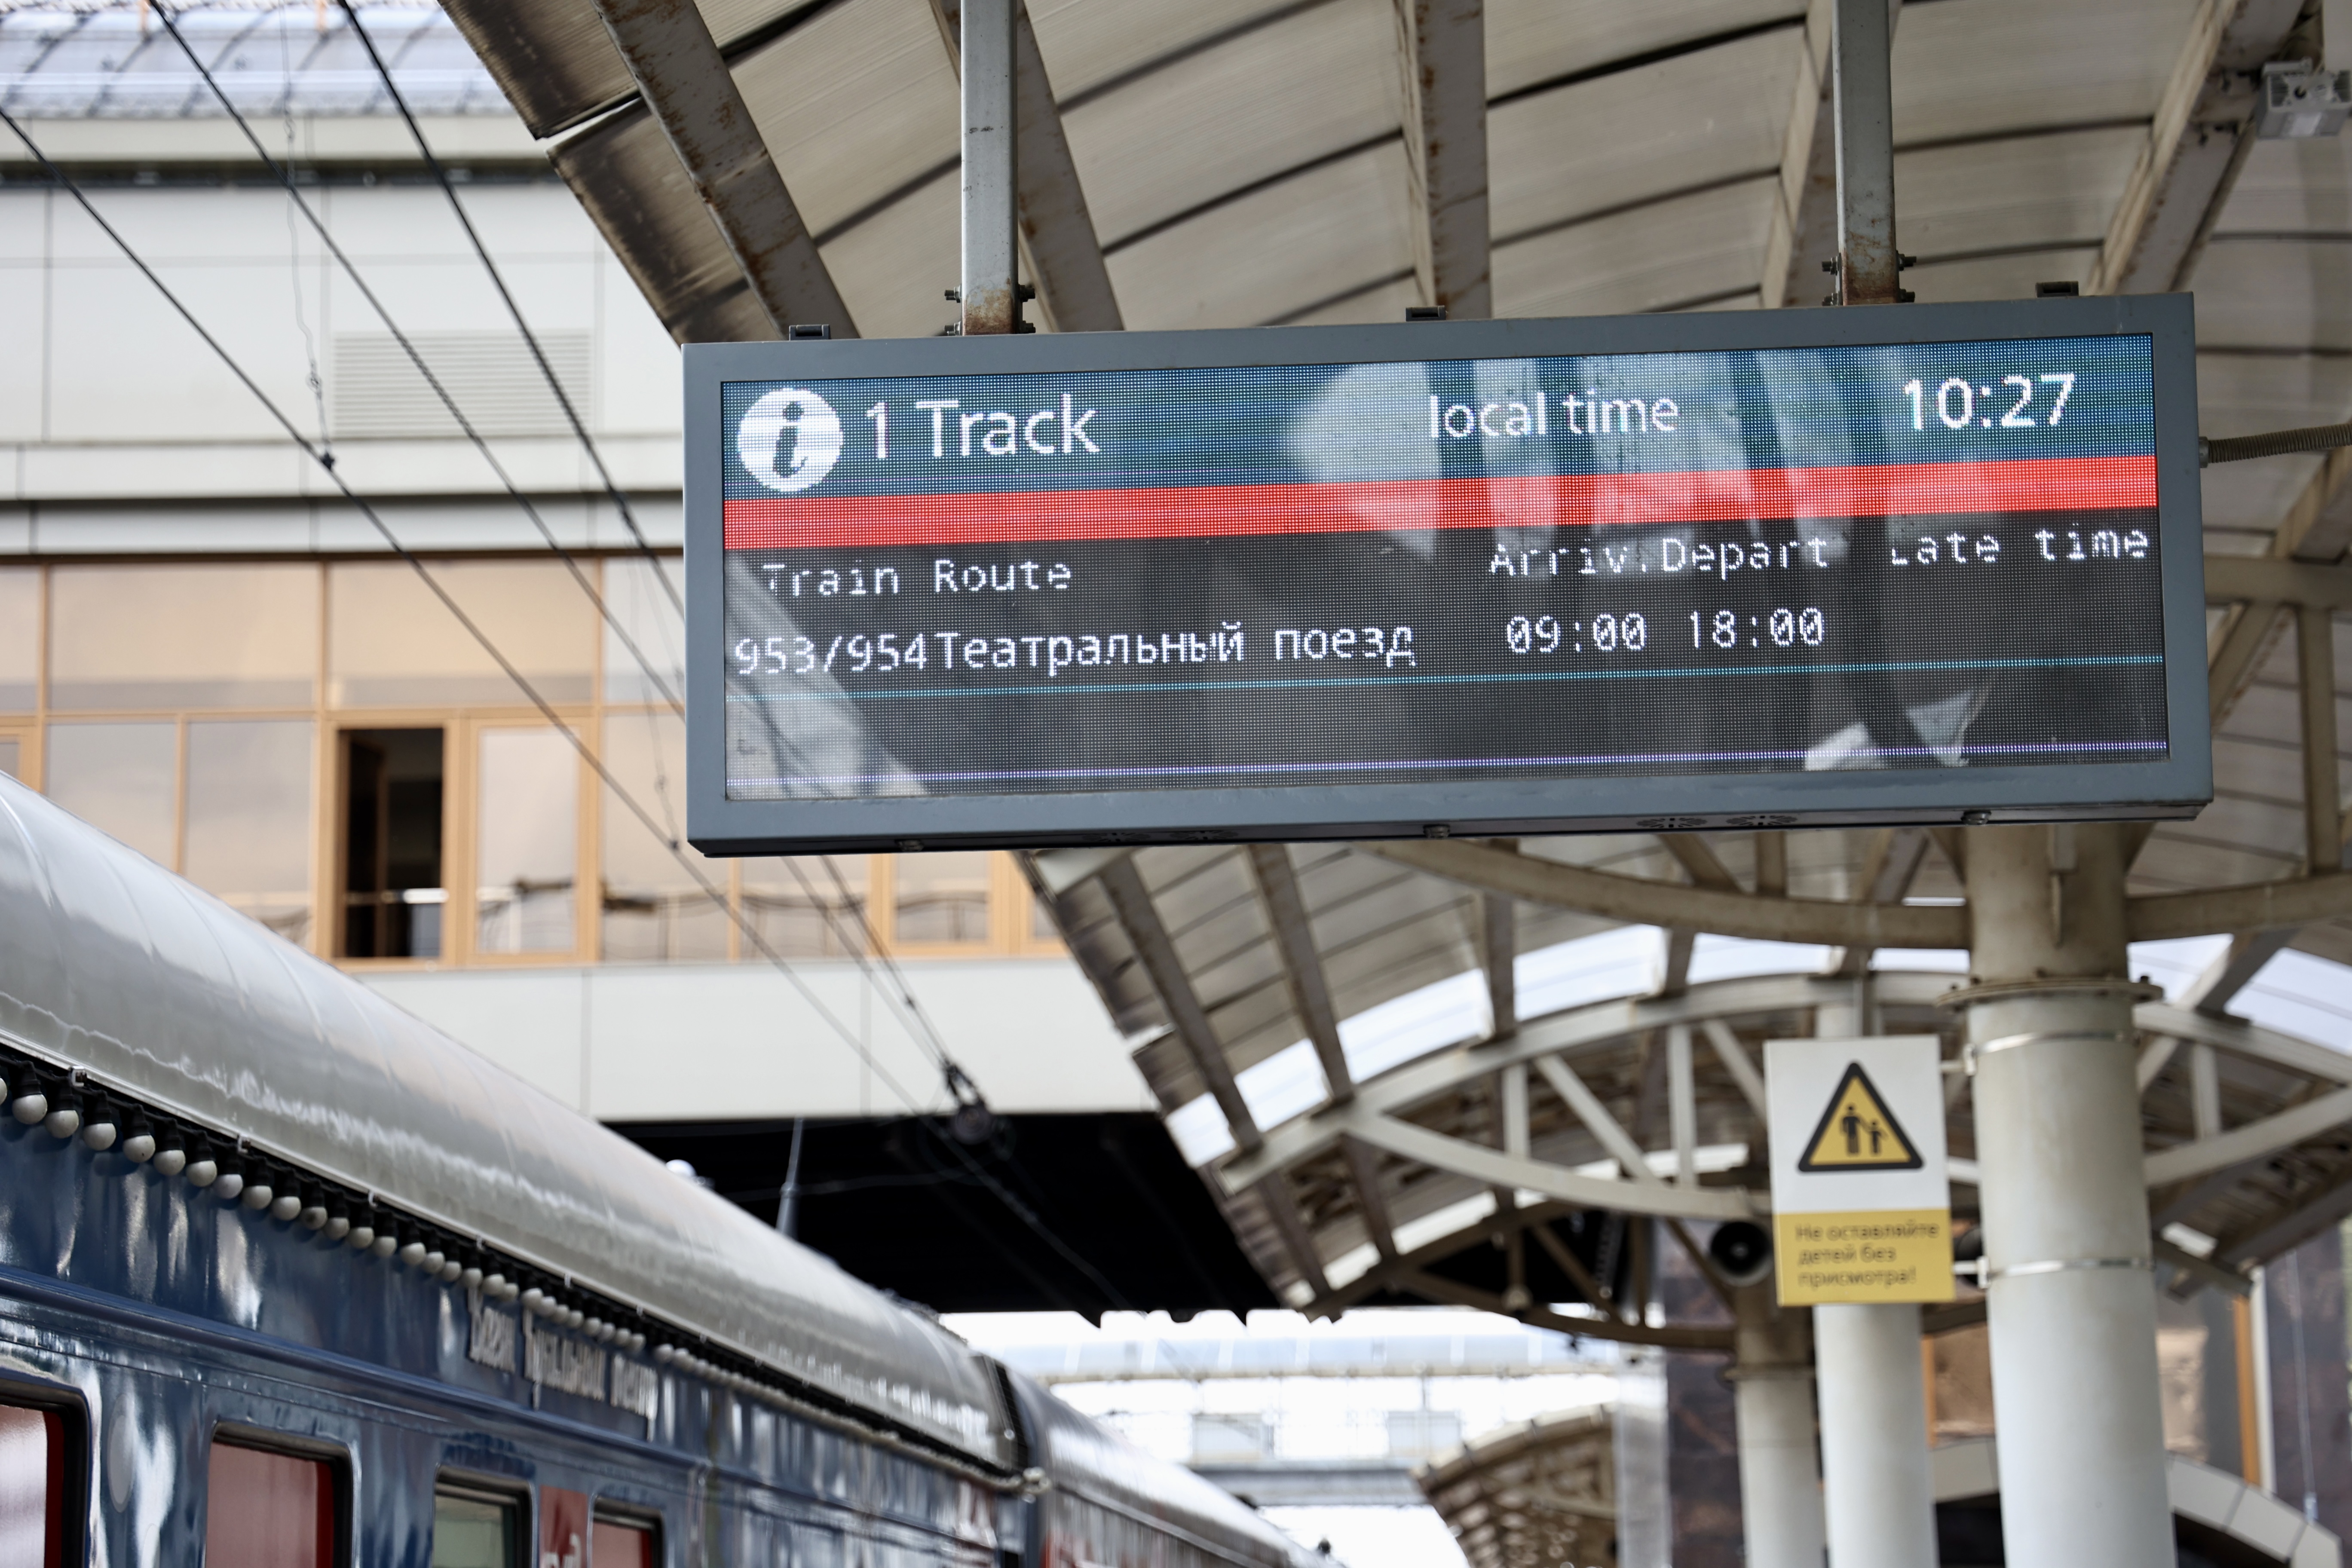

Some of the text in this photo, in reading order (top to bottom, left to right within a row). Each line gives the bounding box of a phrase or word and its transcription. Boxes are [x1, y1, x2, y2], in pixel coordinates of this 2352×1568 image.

[865, 393, 1100, 459] 1 Track
[1429, 387, 1679, 438] local time
[1904, 372, 2075, 430] 10:27
[762, 560, 898, 597] Train
[934, 559, 1072, 593] Route
[2035, 522, 2150, 561] time
[1275, 626, 1417, 668] поезд
[1506, 612, 1647, 654] 09:00
[1690, 607, 1824, 649] 18:00
[1796, 1224, 1823, 1241] Не
[1798, 1243, 1897, 1265] детей без
[1798, 1265, 1917, 1289] присмотра!
